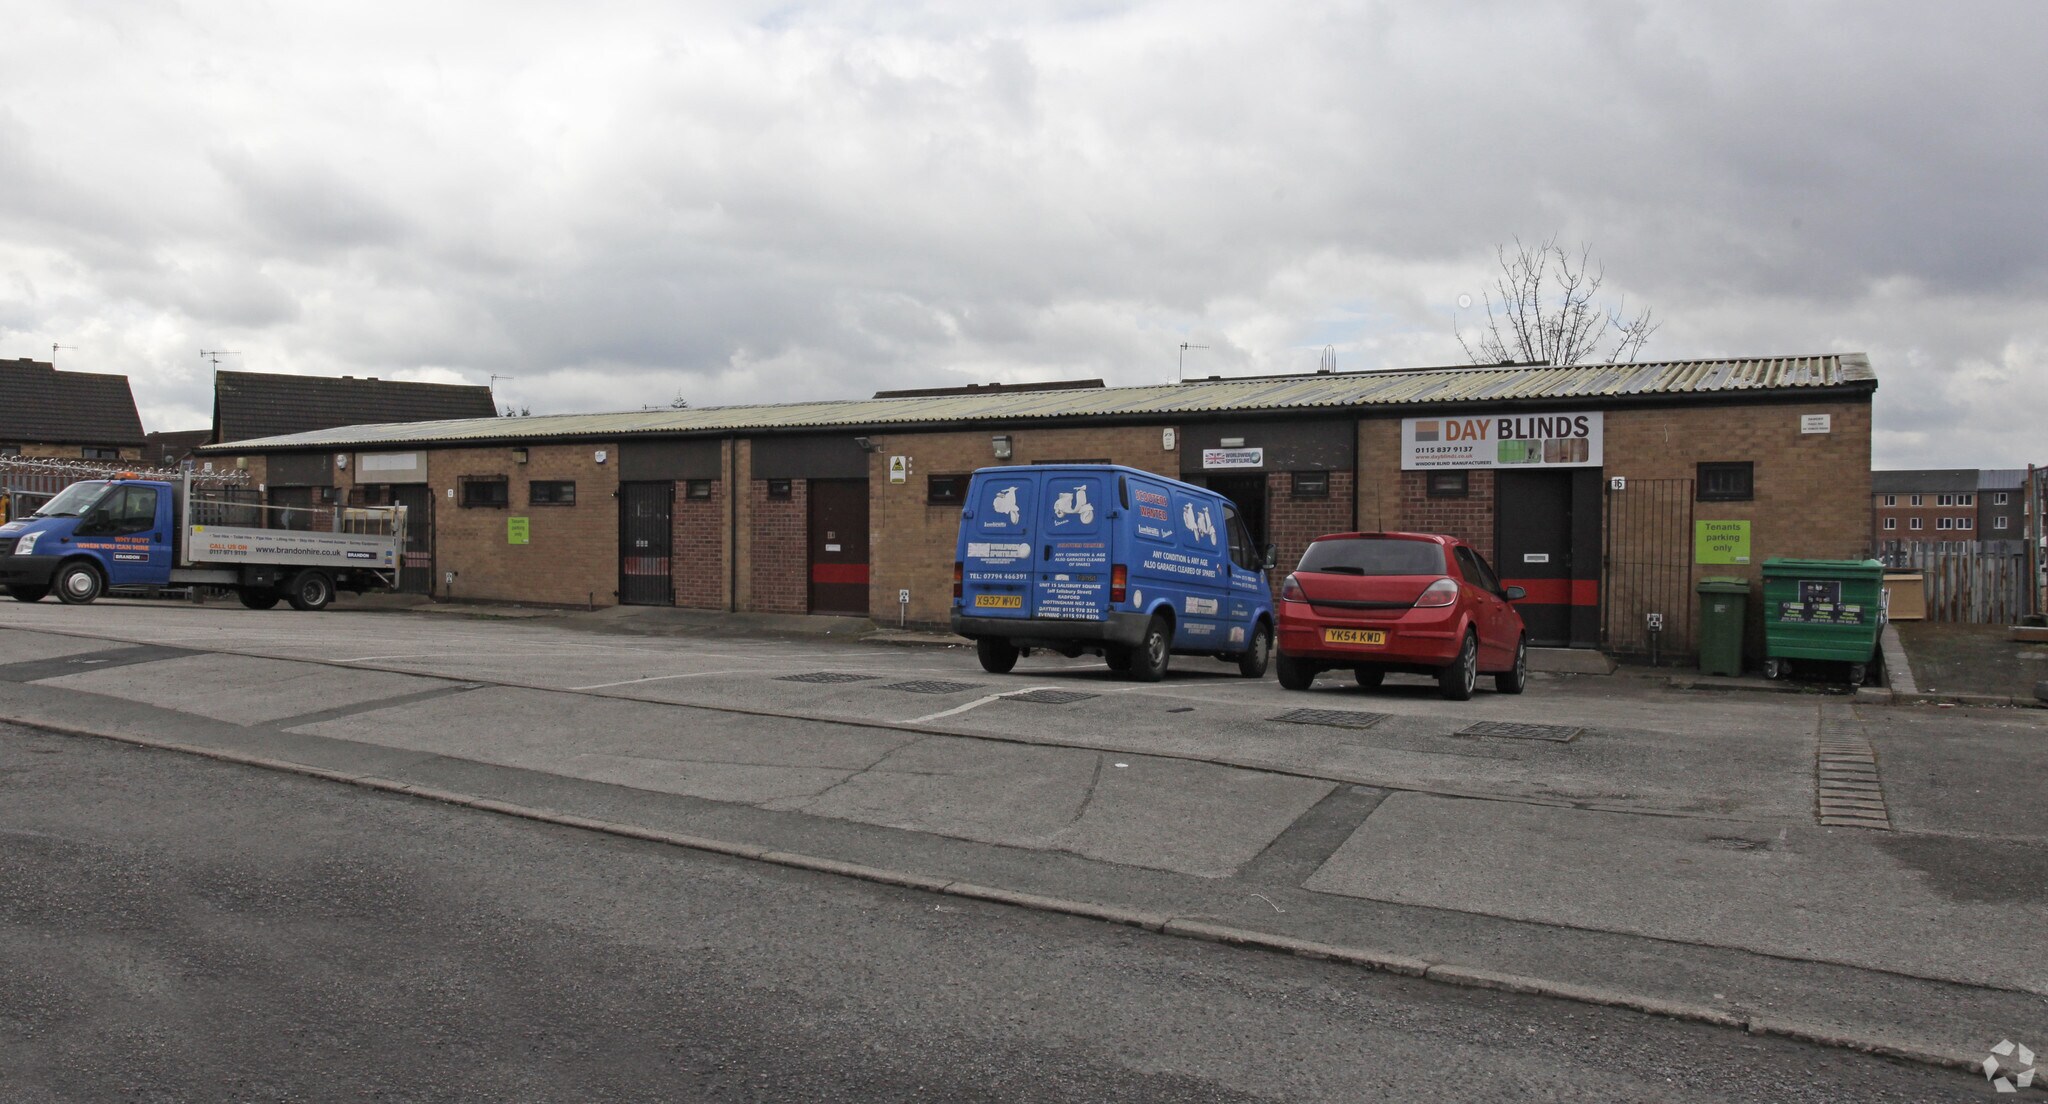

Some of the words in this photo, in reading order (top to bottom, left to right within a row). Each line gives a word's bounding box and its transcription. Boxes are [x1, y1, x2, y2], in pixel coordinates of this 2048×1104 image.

[1445, 419, 1491, 441] DAY
[1497, 416, 1590, 440] BLINDS
[1135, 489, 1168, 507] SCOOTERS
[1140, 505, 1168, 521] WANTED
[1705, 523, 1741, 531] Tenants
[1706, 534, 1740, 543] parking
[255, 546, 342, 557] www.brandonhire.co.uk
[1713, 544, 1733, 553] only
[1163, 552, 1186, 563] CONDITION
[1200, 558, 1208, 567] AGE
[1143, 560, 1156, 569] ALSO
[1156, 562, 1177, 572] GARAGES
[1177, 565, 1195, 575] CLEARED
[1195, 568, 1202, 576] OF
[1202, 569, 1216, 578] SPARES
[976, 596, 1001, 606] X937
[1330, 630, 1357, 641] YK54
[1360, 631, 1381, 643] KWD
